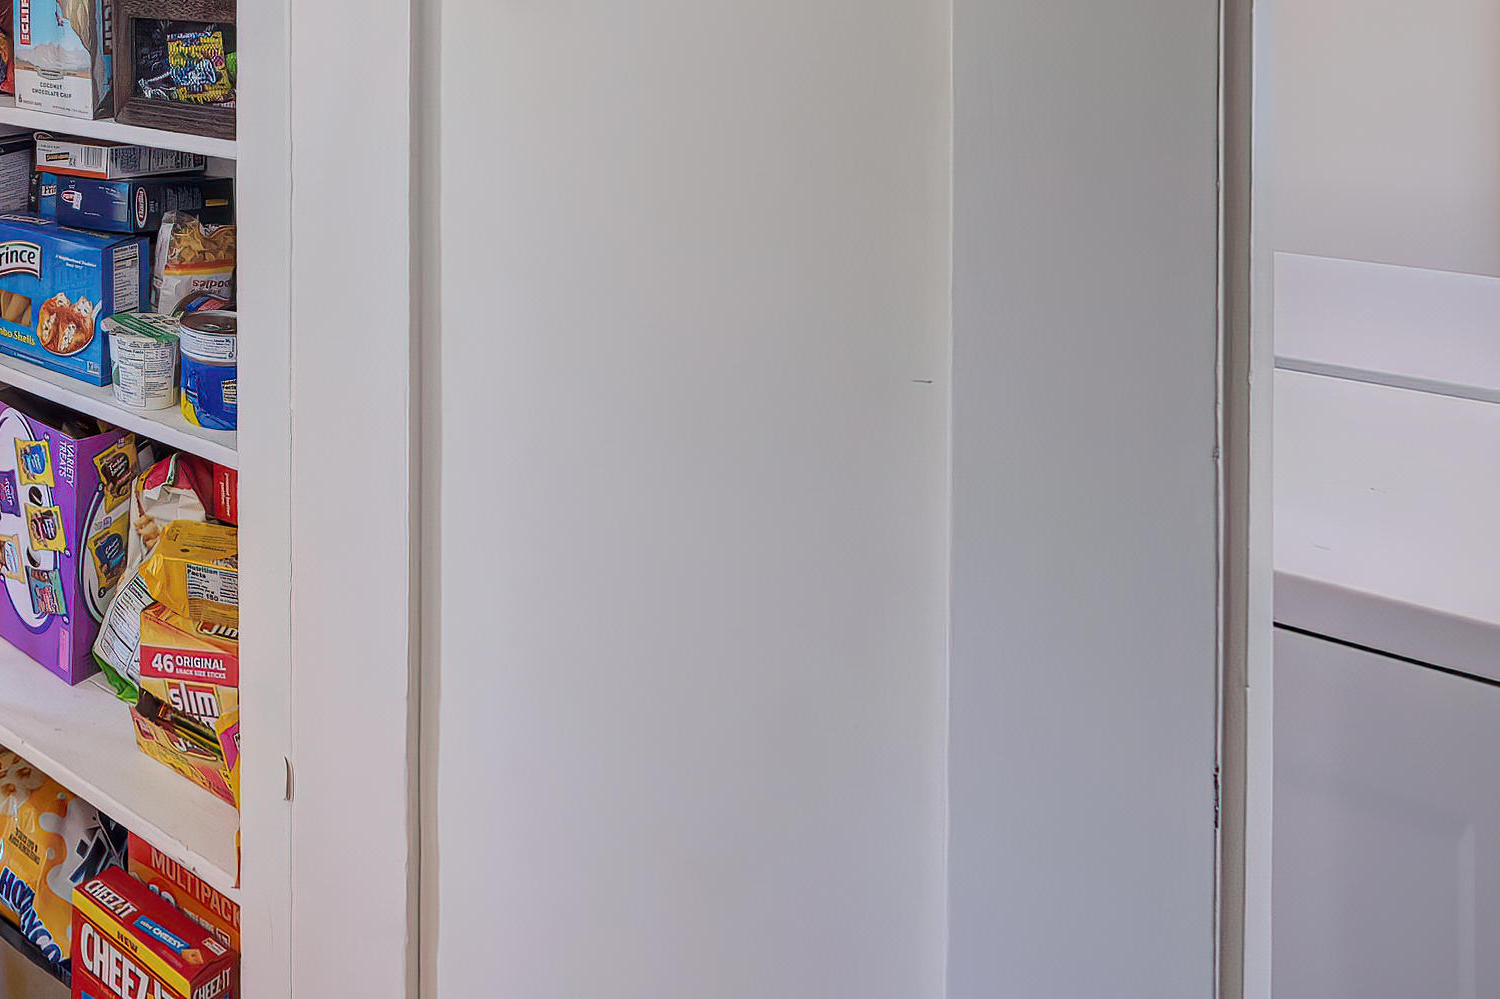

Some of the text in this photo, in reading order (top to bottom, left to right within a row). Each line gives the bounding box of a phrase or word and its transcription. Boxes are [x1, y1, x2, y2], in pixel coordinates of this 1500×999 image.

[32, 88, 72, 99] CHOCOLATE CHIP
[40, 82, 62, 90] COCONUT
[192, 279, 231, 290] oodles
[13, 329, 36, 346] Shells
[59, 440, 67, 478] TREATS
[67, 443, 76, 488] VARIETY
[187, 564, 218, 575] Nutrition
[187, 570, 206, 579] Facts
[151, 653, 226, 674] 46 ORIGINAL
[169, 681, 220, 717] slim
[84, 879, 138, 919] CHEEZ-IT
[116, 930, 139, 953] NEW
